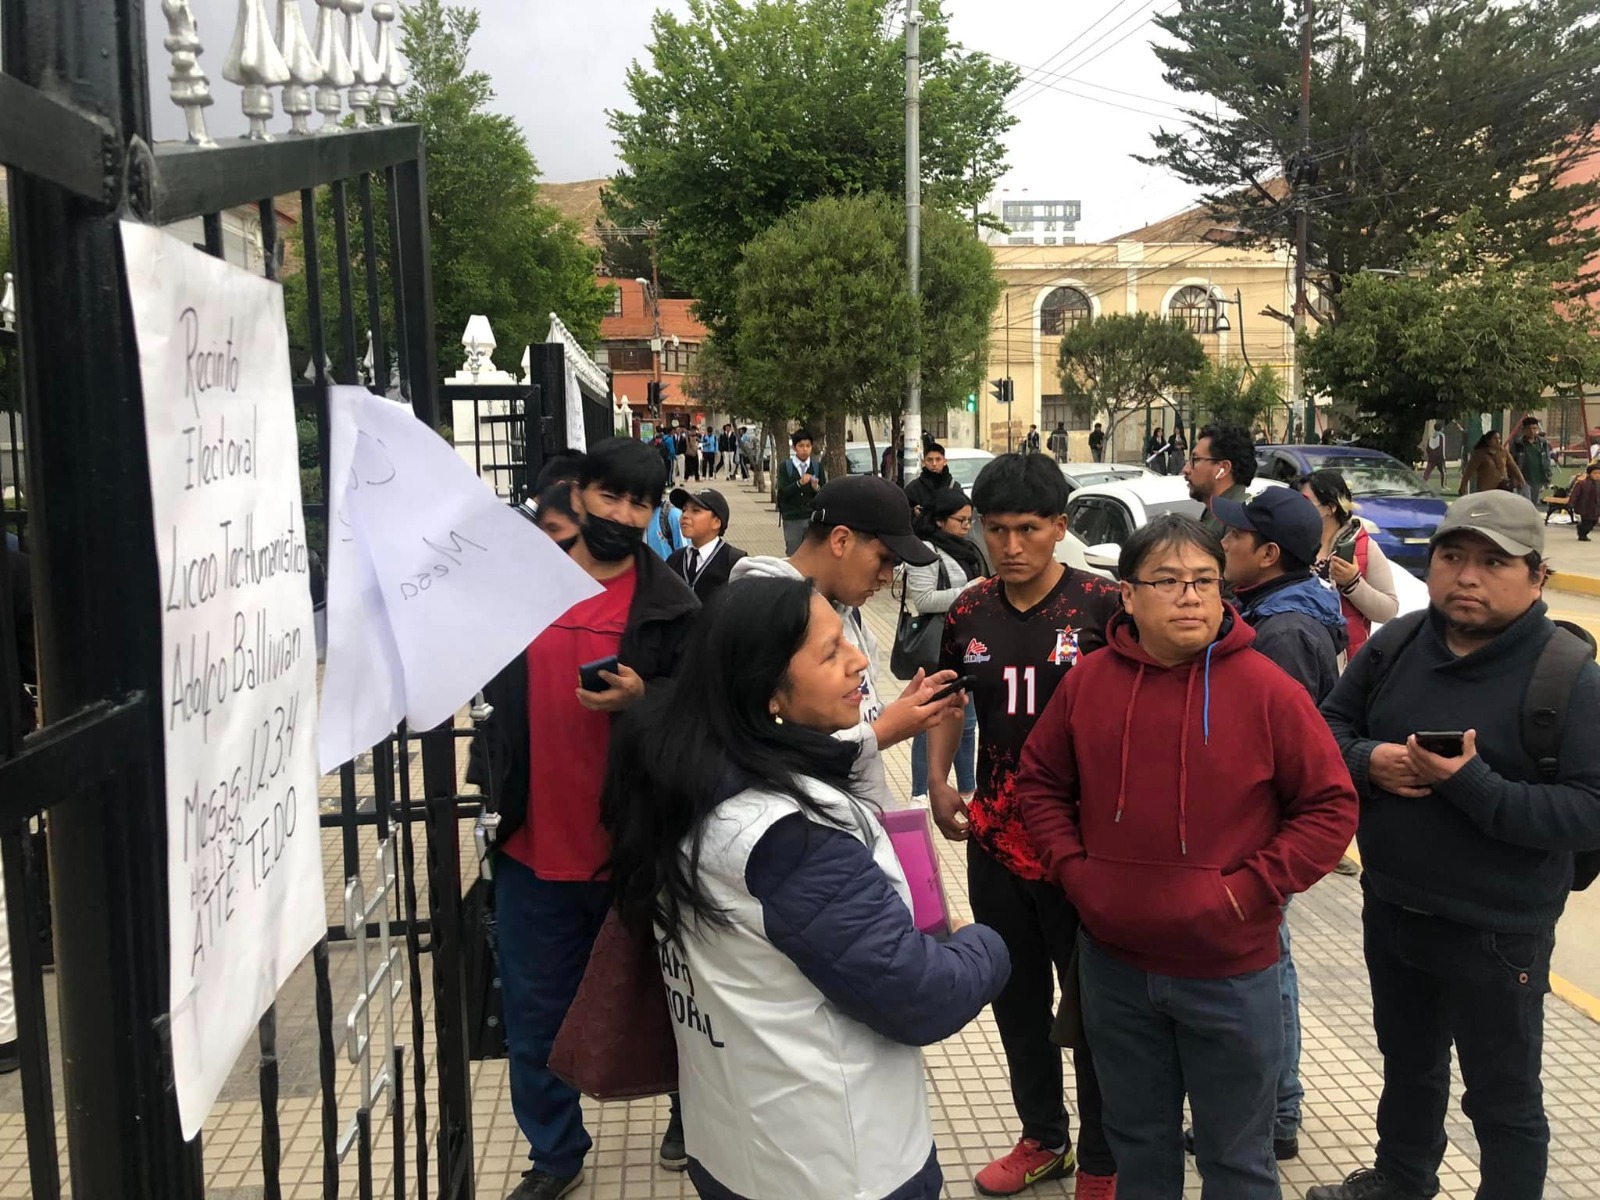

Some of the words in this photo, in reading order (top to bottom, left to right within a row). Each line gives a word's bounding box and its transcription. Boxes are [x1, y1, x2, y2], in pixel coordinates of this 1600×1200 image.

[180, 306, 240, 419] Recinto
[166, 523, 218, 613] Liceo
[232, 608, 301, 693] Ballivian
[1002, 665, 1036, 716] 11
